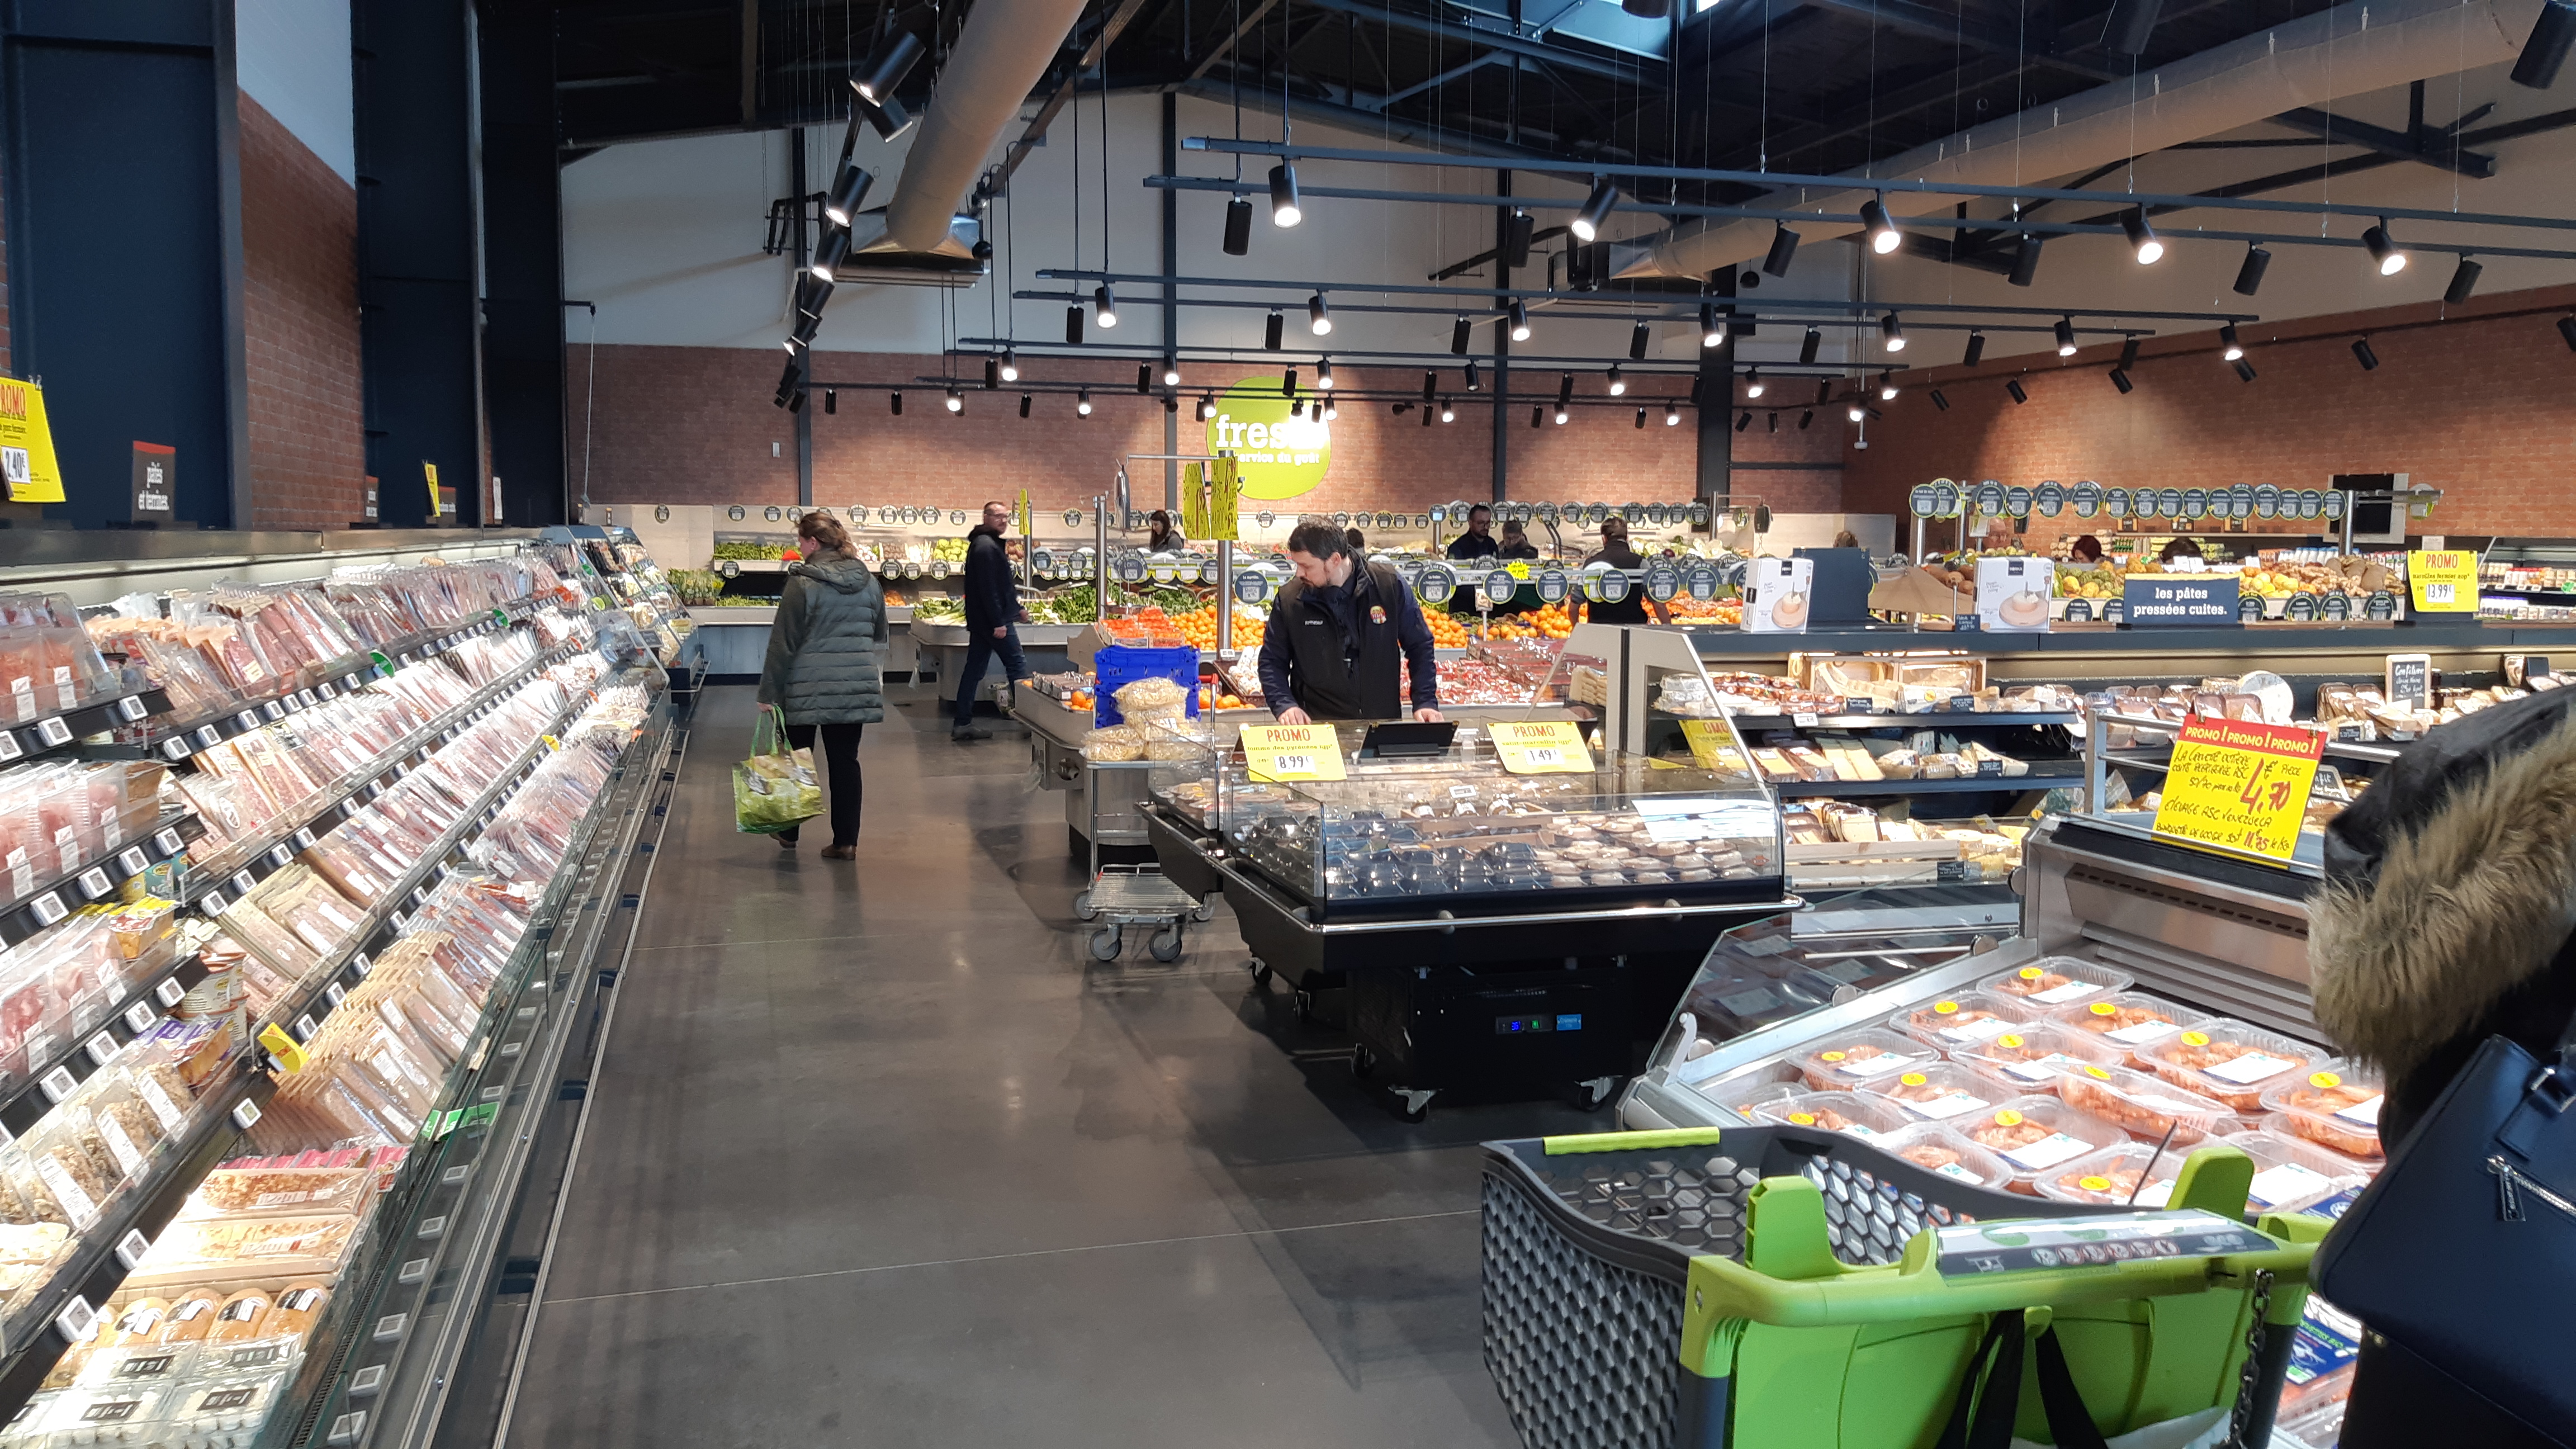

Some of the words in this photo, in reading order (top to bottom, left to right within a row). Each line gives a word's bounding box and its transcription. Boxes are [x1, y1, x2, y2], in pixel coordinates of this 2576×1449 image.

[0, 383, 26, 416] ROMO
[1216, 414, 1313, 449] fres
[1294, 452, 1320, 466] goût
[2426, 553, 2458, 569] PROMO
[2155, 587, 2173, 599] les
[2176, 586, 2208, 602] pâtes
[2133, 603, 2186, 618] pressées
[2189, 603, 2227, 615] cuites.
[1266, 728, 1311, 742] PROMO
[1513, 724, 1555, 737] PROMO
